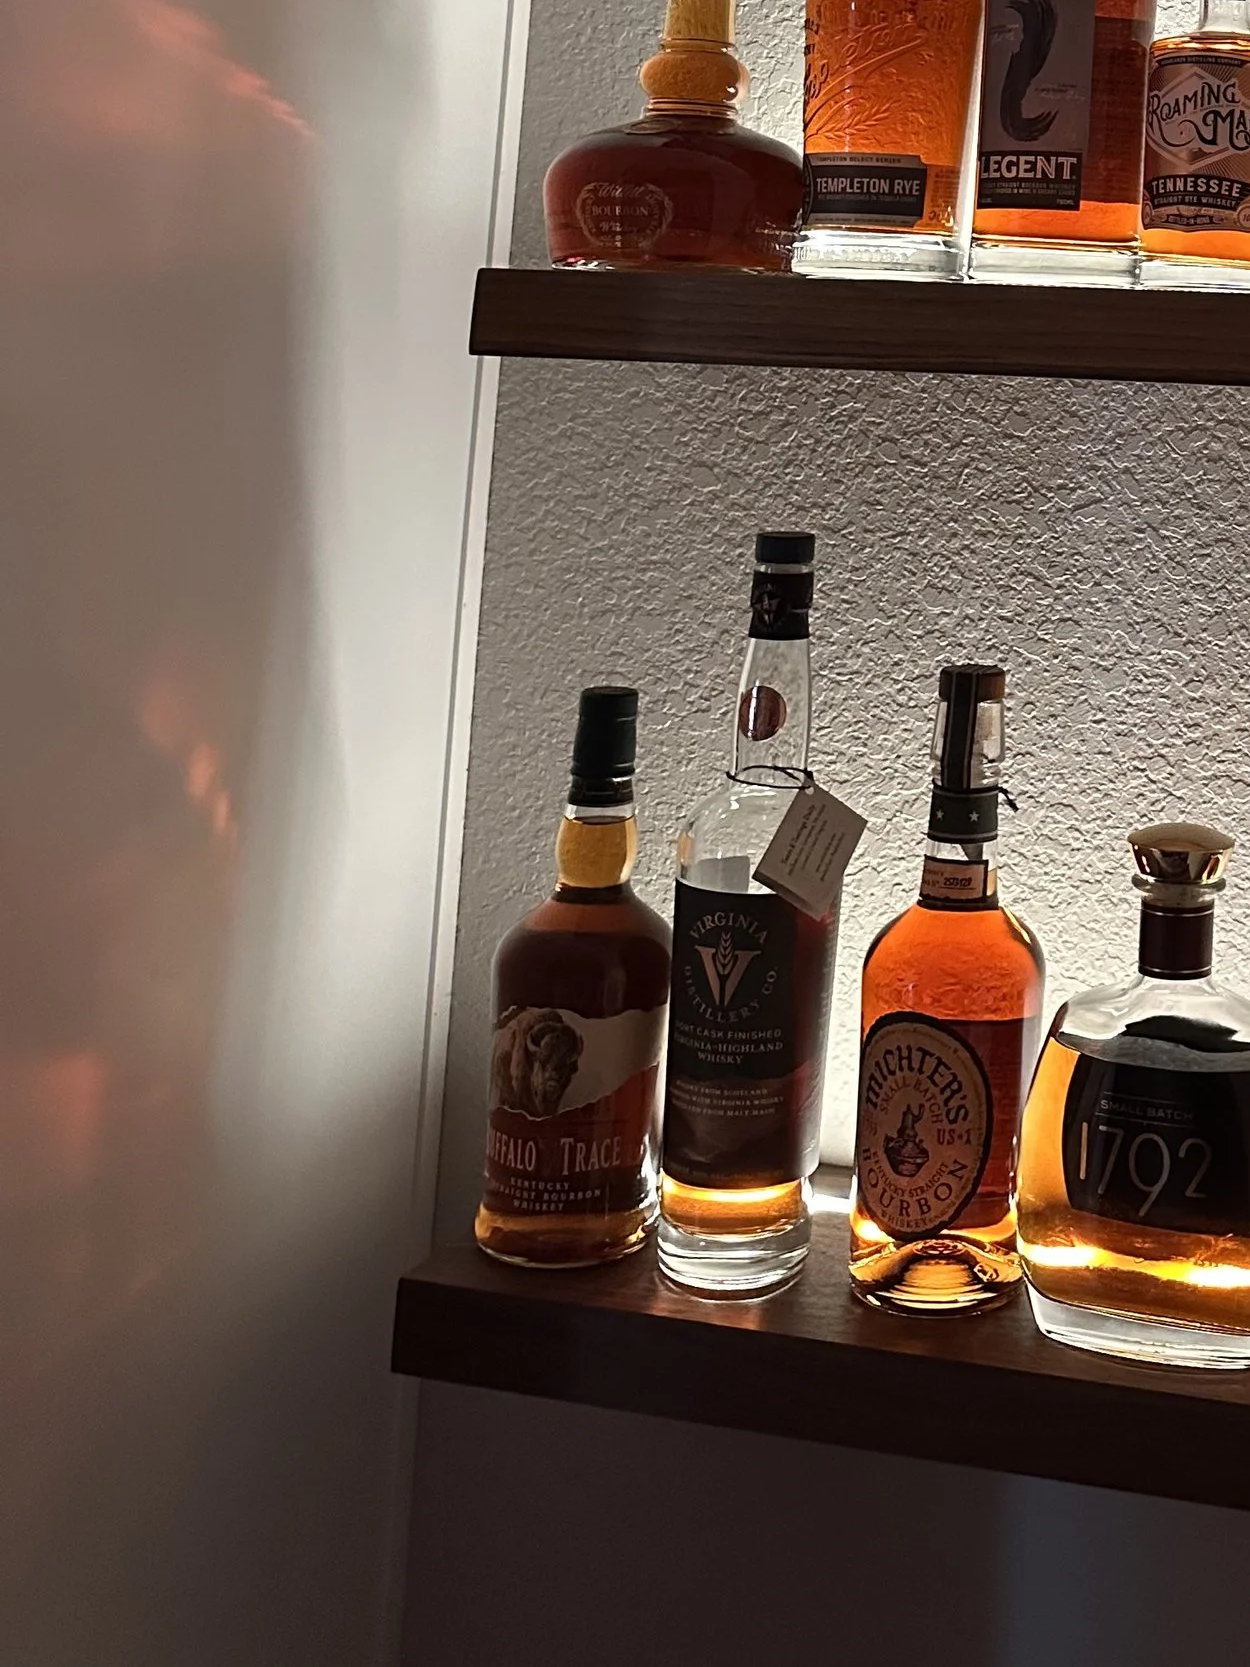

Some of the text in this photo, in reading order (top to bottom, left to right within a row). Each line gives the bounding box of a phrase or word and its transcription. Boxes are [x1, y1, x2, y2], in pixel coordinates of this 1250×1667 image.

[1150, 81, 1240, 134] ROAMING
[980, 156, 1077, 180] LEGENT
[816, 177, 920, 195] TEMPLETON RYE
[1152, 177, 1242, 197] TENNESSEE
[592, 205, 649, 217] BOURBON
[1201, 198, 1236, 207] WHISKEY
[690, 912, 768, 945] VIRGINIA
[684, 965, 761, 1023] DISTILLERY
[697, 1027, 724, 1038] CASK
[728, 1028, 782, 1040] FINISHED
[697, 1052, 744, 1064] WHISKY
[866, 1044, 970, 1126] MICHTER'S
[880, 1075, 943, 1125] SMALL BATCH
[1100, 1099, 1194, 1120] SMALL BATCH
[560, 1136, 622, 1176] TRACE
[1079, 1122, 1212, 1217] 1792
[511, 1177, 570, 1190] KENTUCKY
[862, 1148, 969, 1218] BOURBON
[513, 1199, 565, 1211] WHISKEY
[543, 1189, 601, 1201] BOURBON
